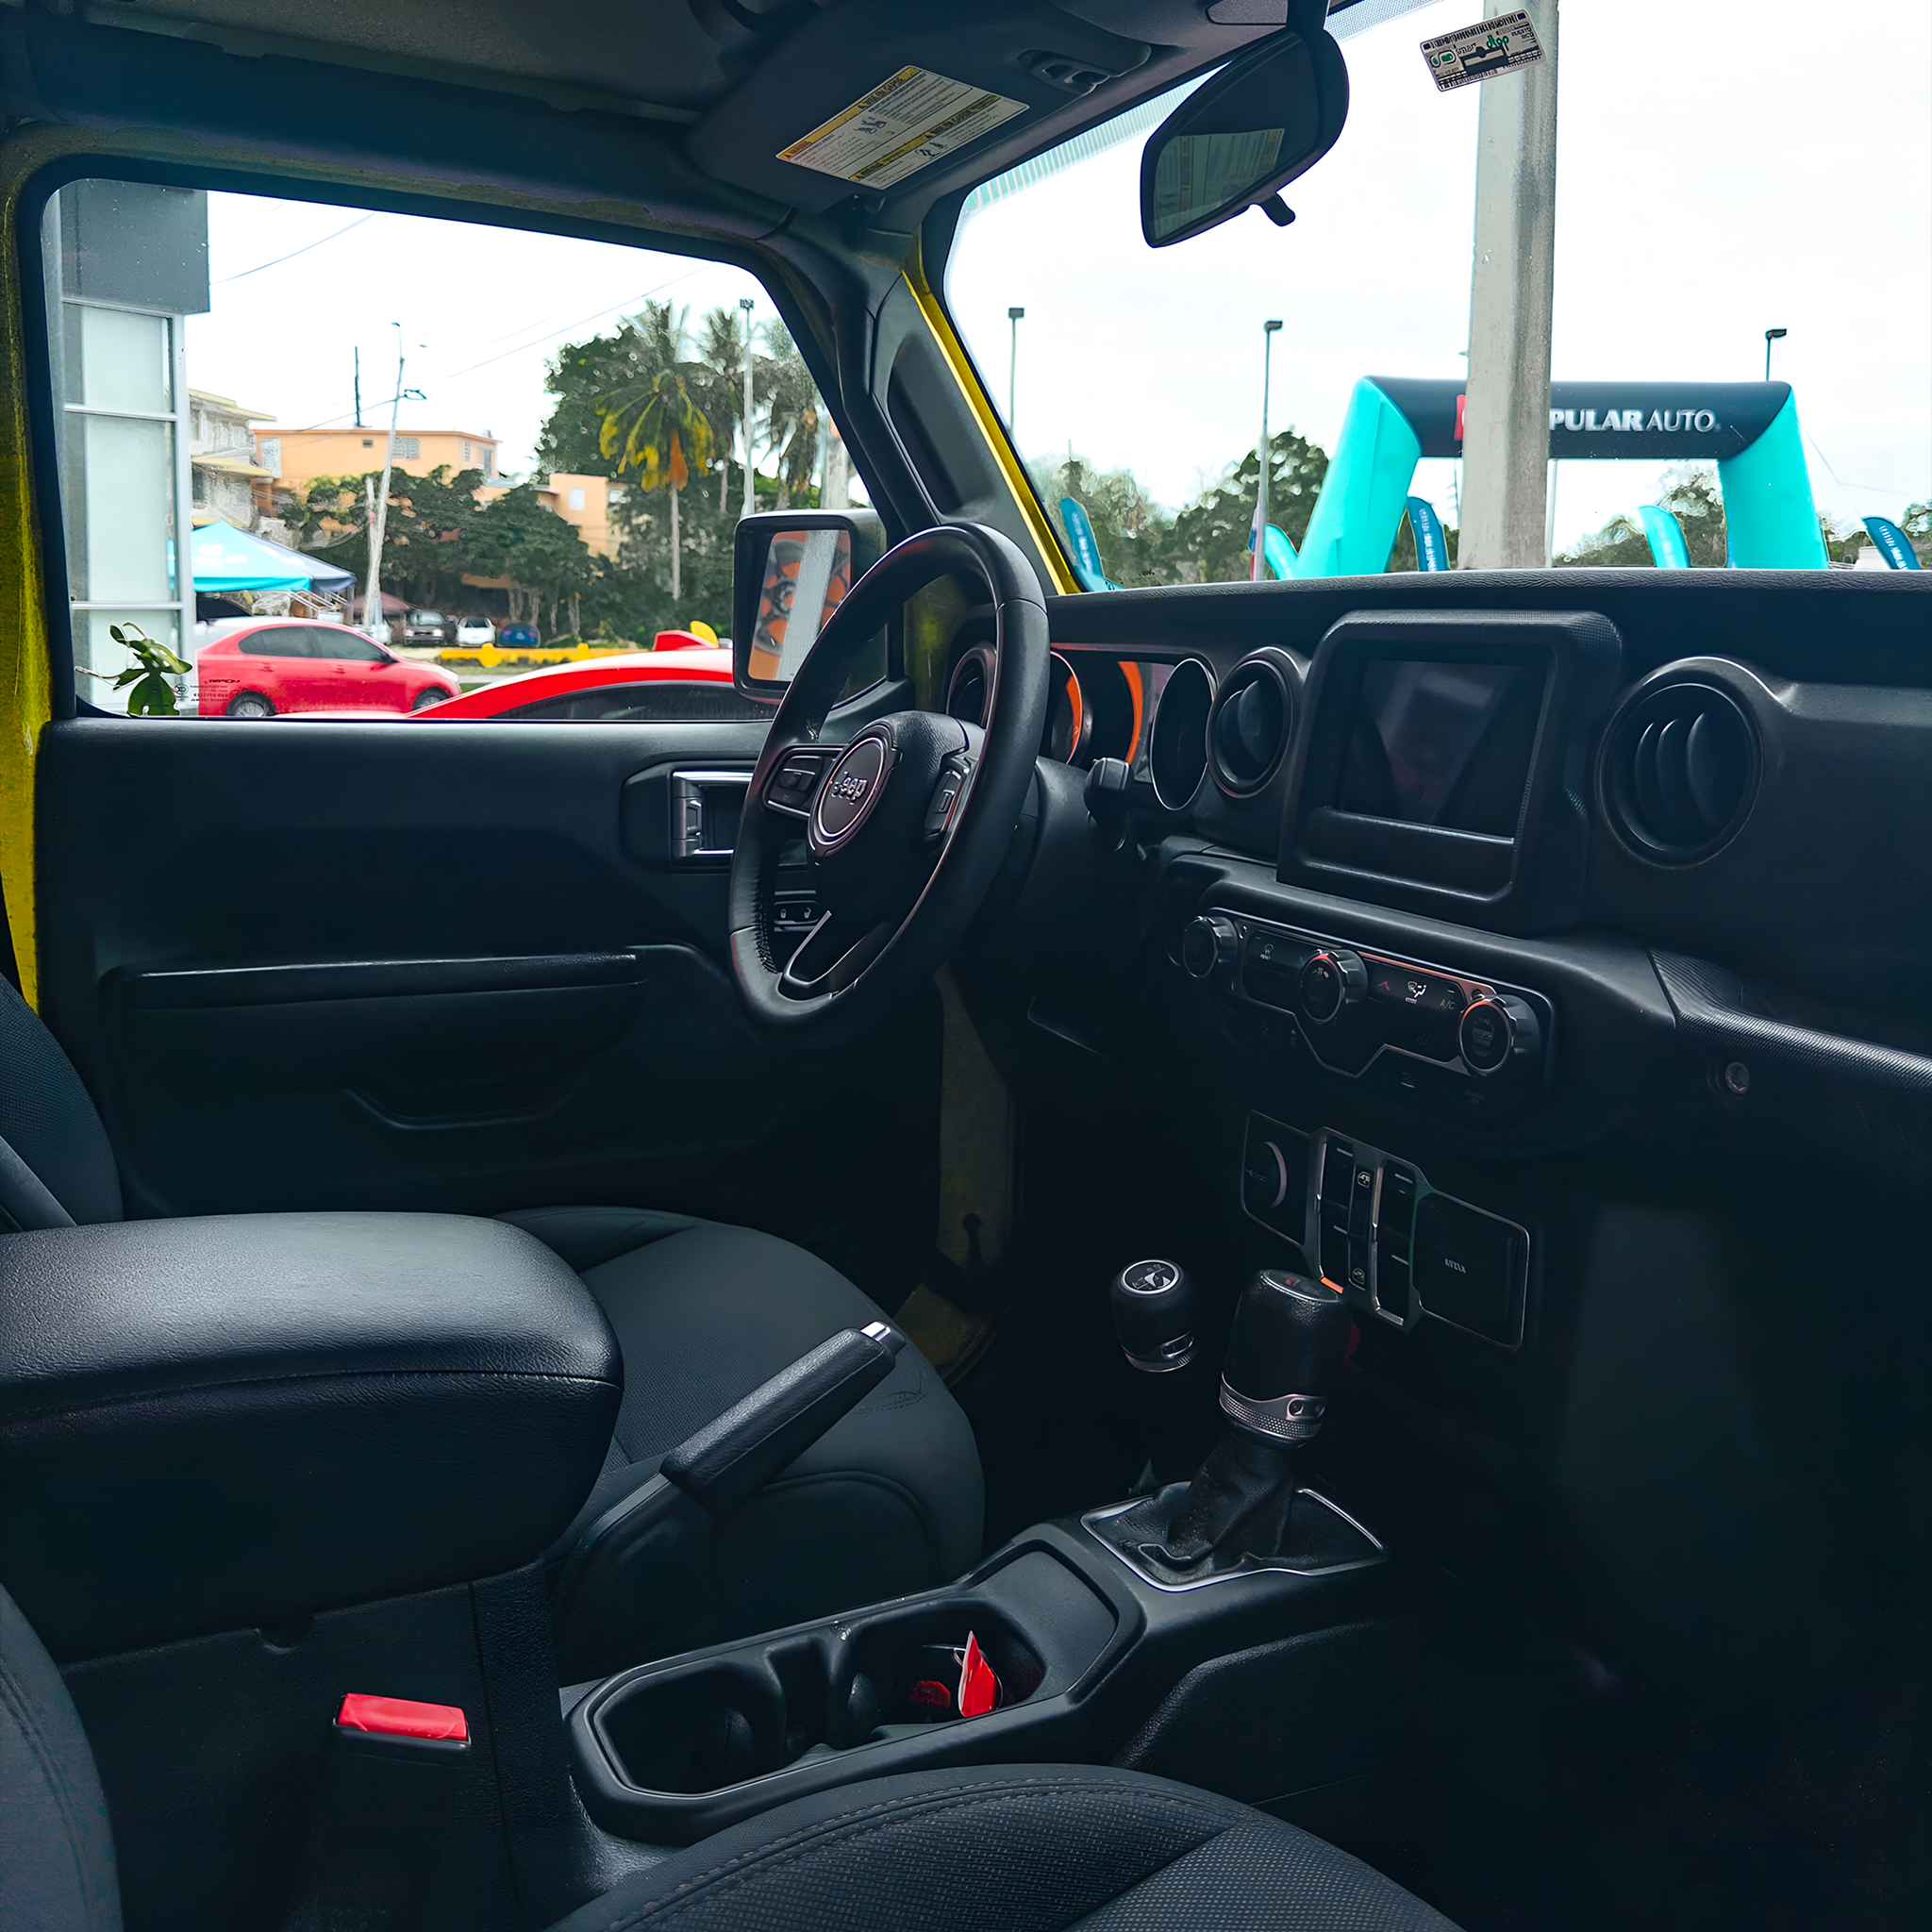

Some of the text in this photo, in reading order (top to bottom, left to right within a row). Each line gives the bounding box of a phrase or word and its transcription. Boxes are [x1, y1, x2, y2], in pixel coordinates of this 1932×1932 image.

[1548, 408, 1716, 432] PULAR AUTO
[831, 771, 868, 806] Jeep
[1440, 999, 1456, 1009] A/C
